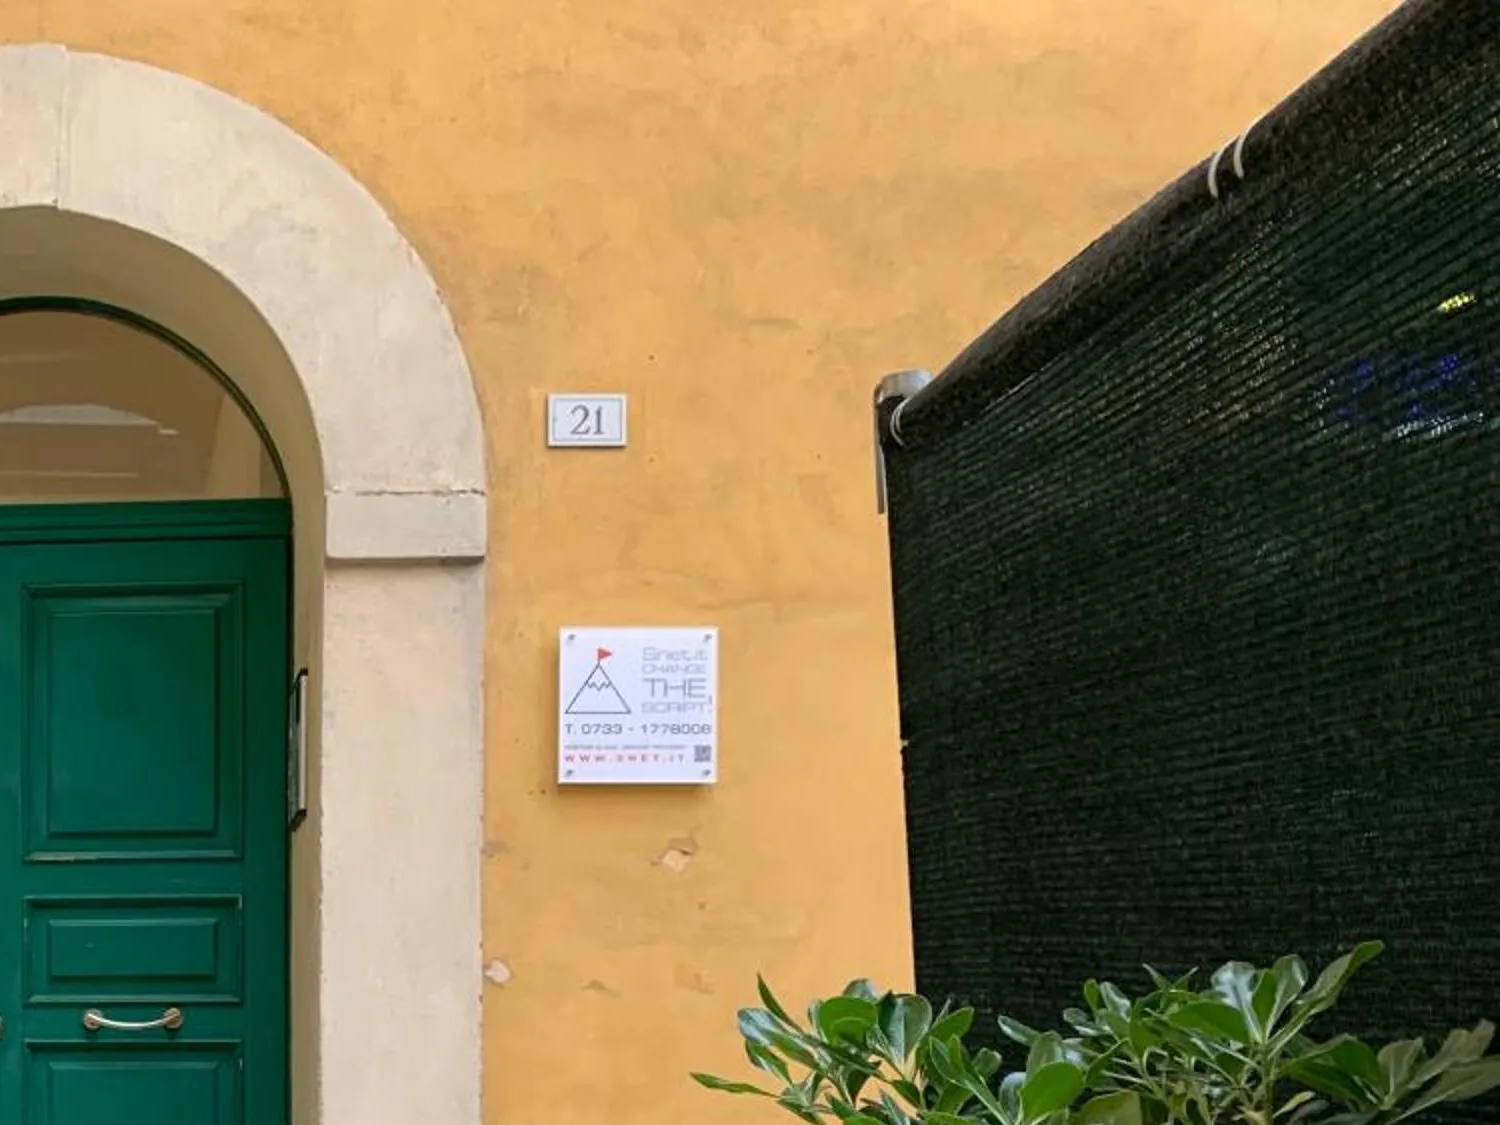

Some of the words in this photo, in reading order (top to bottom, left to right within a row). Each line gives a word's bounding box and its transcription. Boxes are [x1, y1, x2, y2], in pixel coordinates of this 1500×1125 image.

[570, 404, 606, 435] 21
[641, 663, 706, 675] CHANGE
[642, 678, 707, 699] THE
[564, 723, 578, 735] T.
[580, 723, 624, 735] 0733
